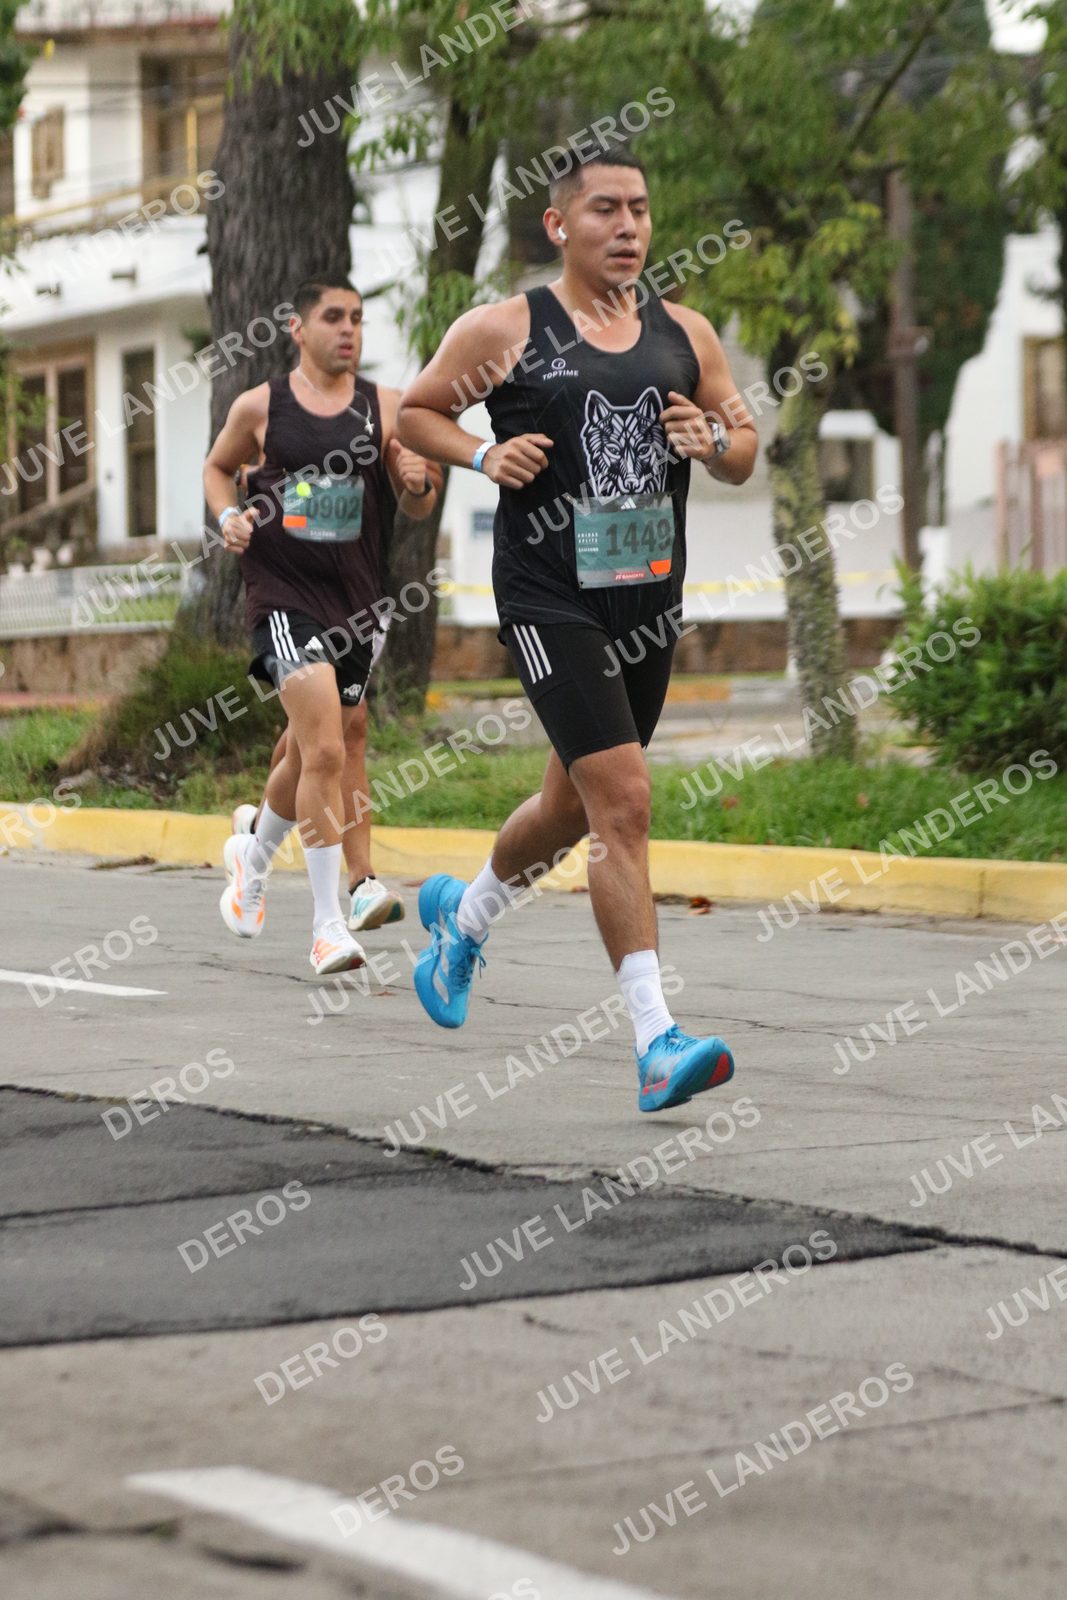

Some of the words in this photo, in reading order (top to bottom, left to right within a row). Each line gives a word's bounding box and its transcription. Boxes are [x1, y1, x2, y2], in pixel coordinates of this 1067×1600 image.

[542, 368, 579, 381] TOPTIME
[304, 493, 359, 520] 0902
[606, 518, 672, 556] 1449
